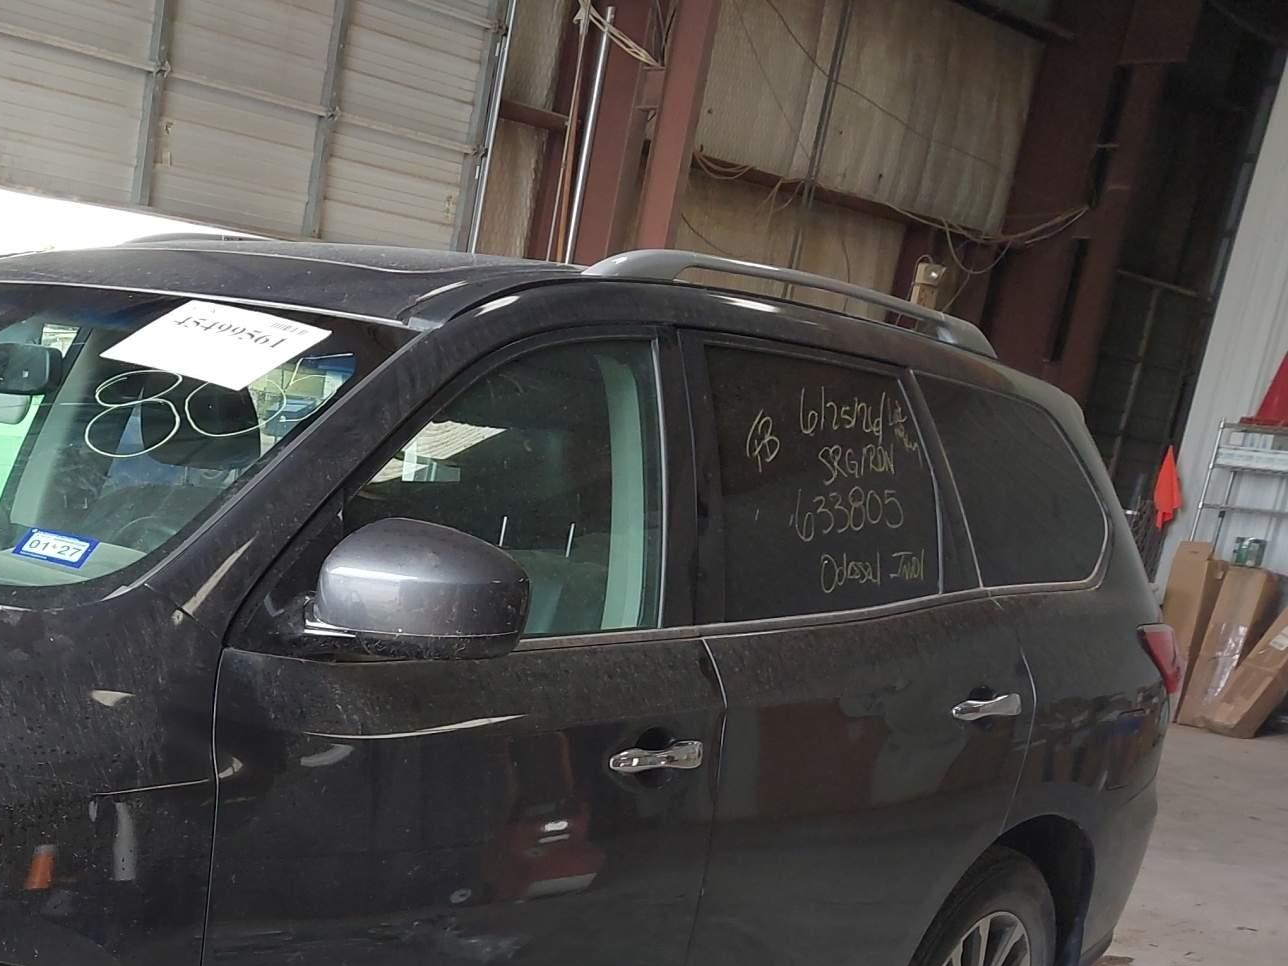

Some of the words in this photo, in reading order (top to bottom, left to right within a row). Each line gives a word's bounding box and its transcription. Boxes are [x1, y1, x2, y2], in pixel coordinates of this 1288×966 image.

[173, 315, 288, 349] 45499561
[794, 486, 904, 542] 633805
[28, 539, 51, 552] 01
[57, 544, 83, 557] 27
